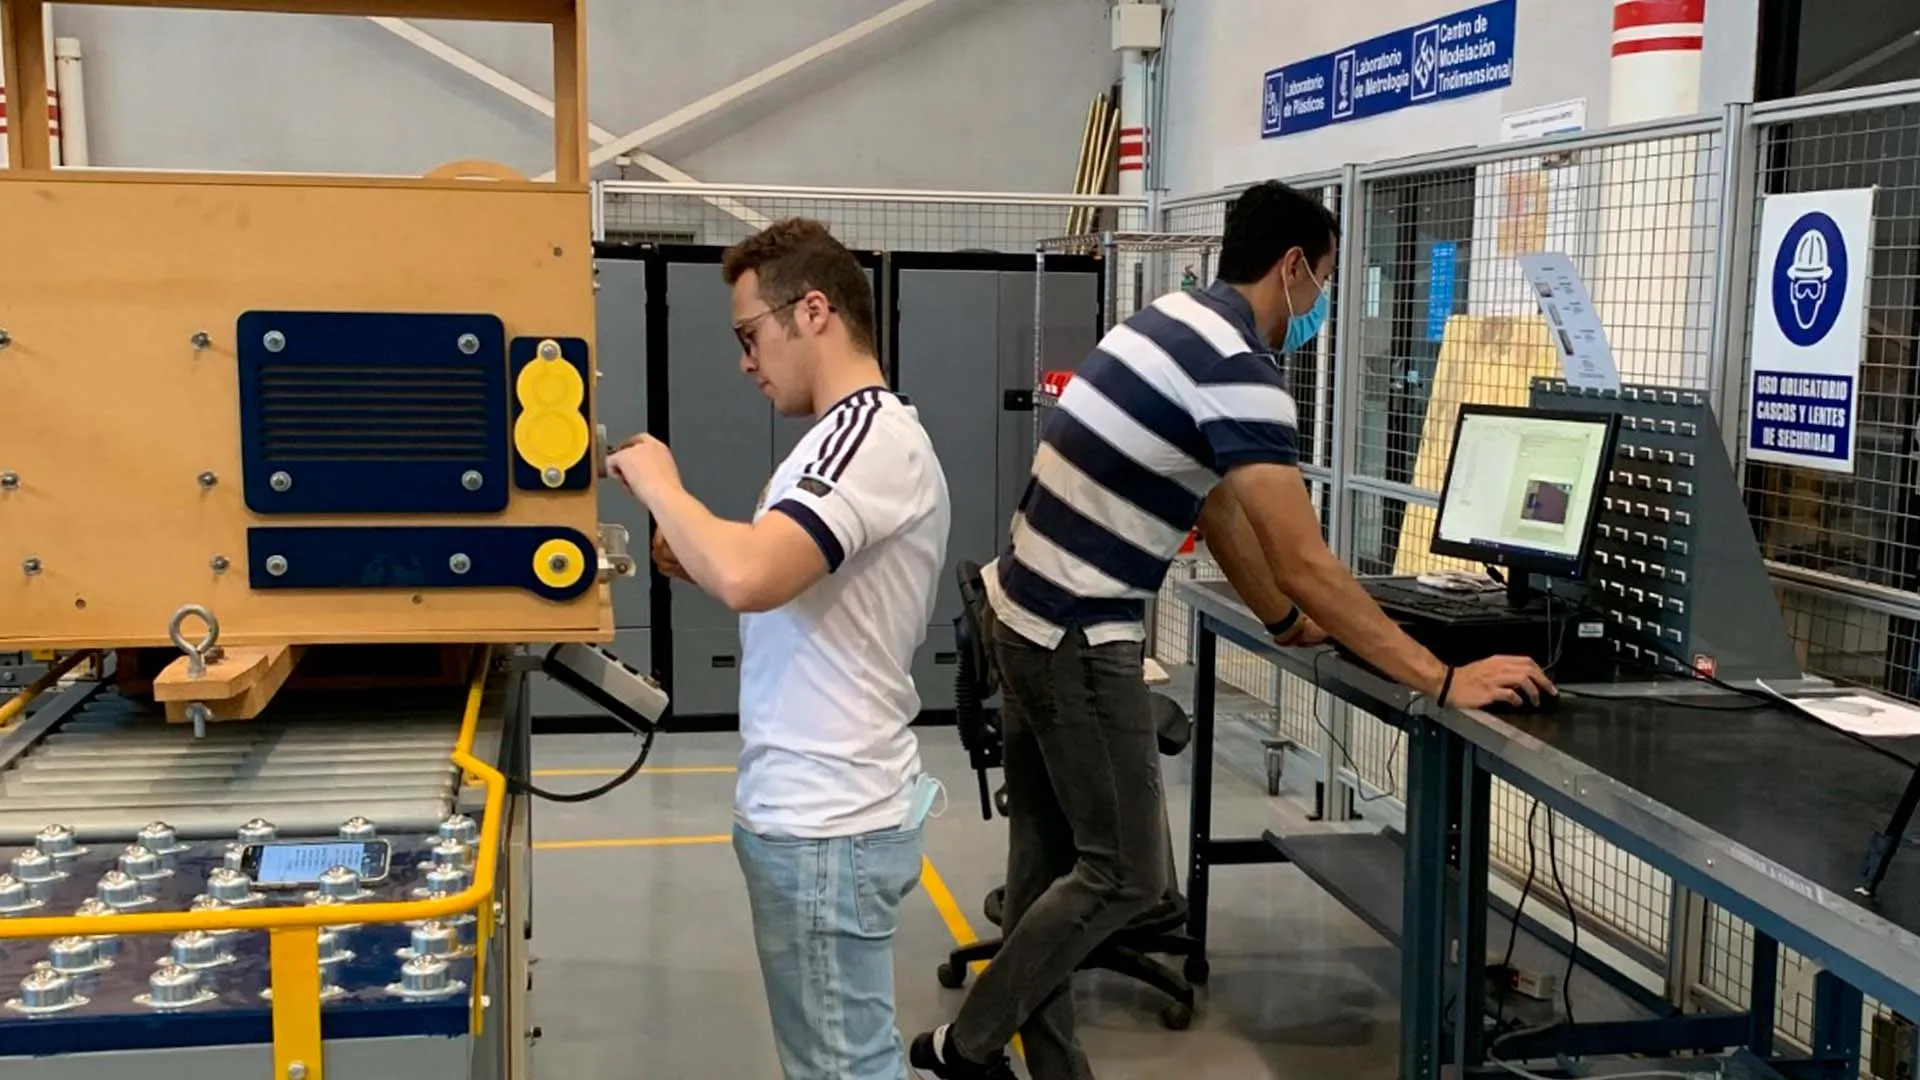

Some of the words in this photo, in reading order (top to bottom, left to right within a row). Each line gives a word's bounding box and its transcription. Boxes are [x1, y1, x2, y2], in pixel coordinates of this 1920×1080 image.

[1440, 20, 1472, 43] Centro
[1474, 14, 1488, 34] de
[1356, 48, 1402, 77] Laboratorio
[1439, 37, 1496, 68] Modelación
[1285, 73, 1325, 98] Laboratorio
[1354, 81, 1363, 99] de
[1365, 69, 1410, 97] Metrología
[1438, 57, 1512, 93] Tridimensional
[1283, 101, 1292, 118] de
[1757, 375, 1778, 395] USO
[1780, 377, 1848, 401] OBLIGATORIO
[1756, 400, 1797, 422] CASCOS
[1799, 404, 1806, 424] Y
[1808, 405, 1846, 428] LENTES
[1762, 426, 1776, 446] DE
[1777, 428, 1836, 453] SEGURIDAD
